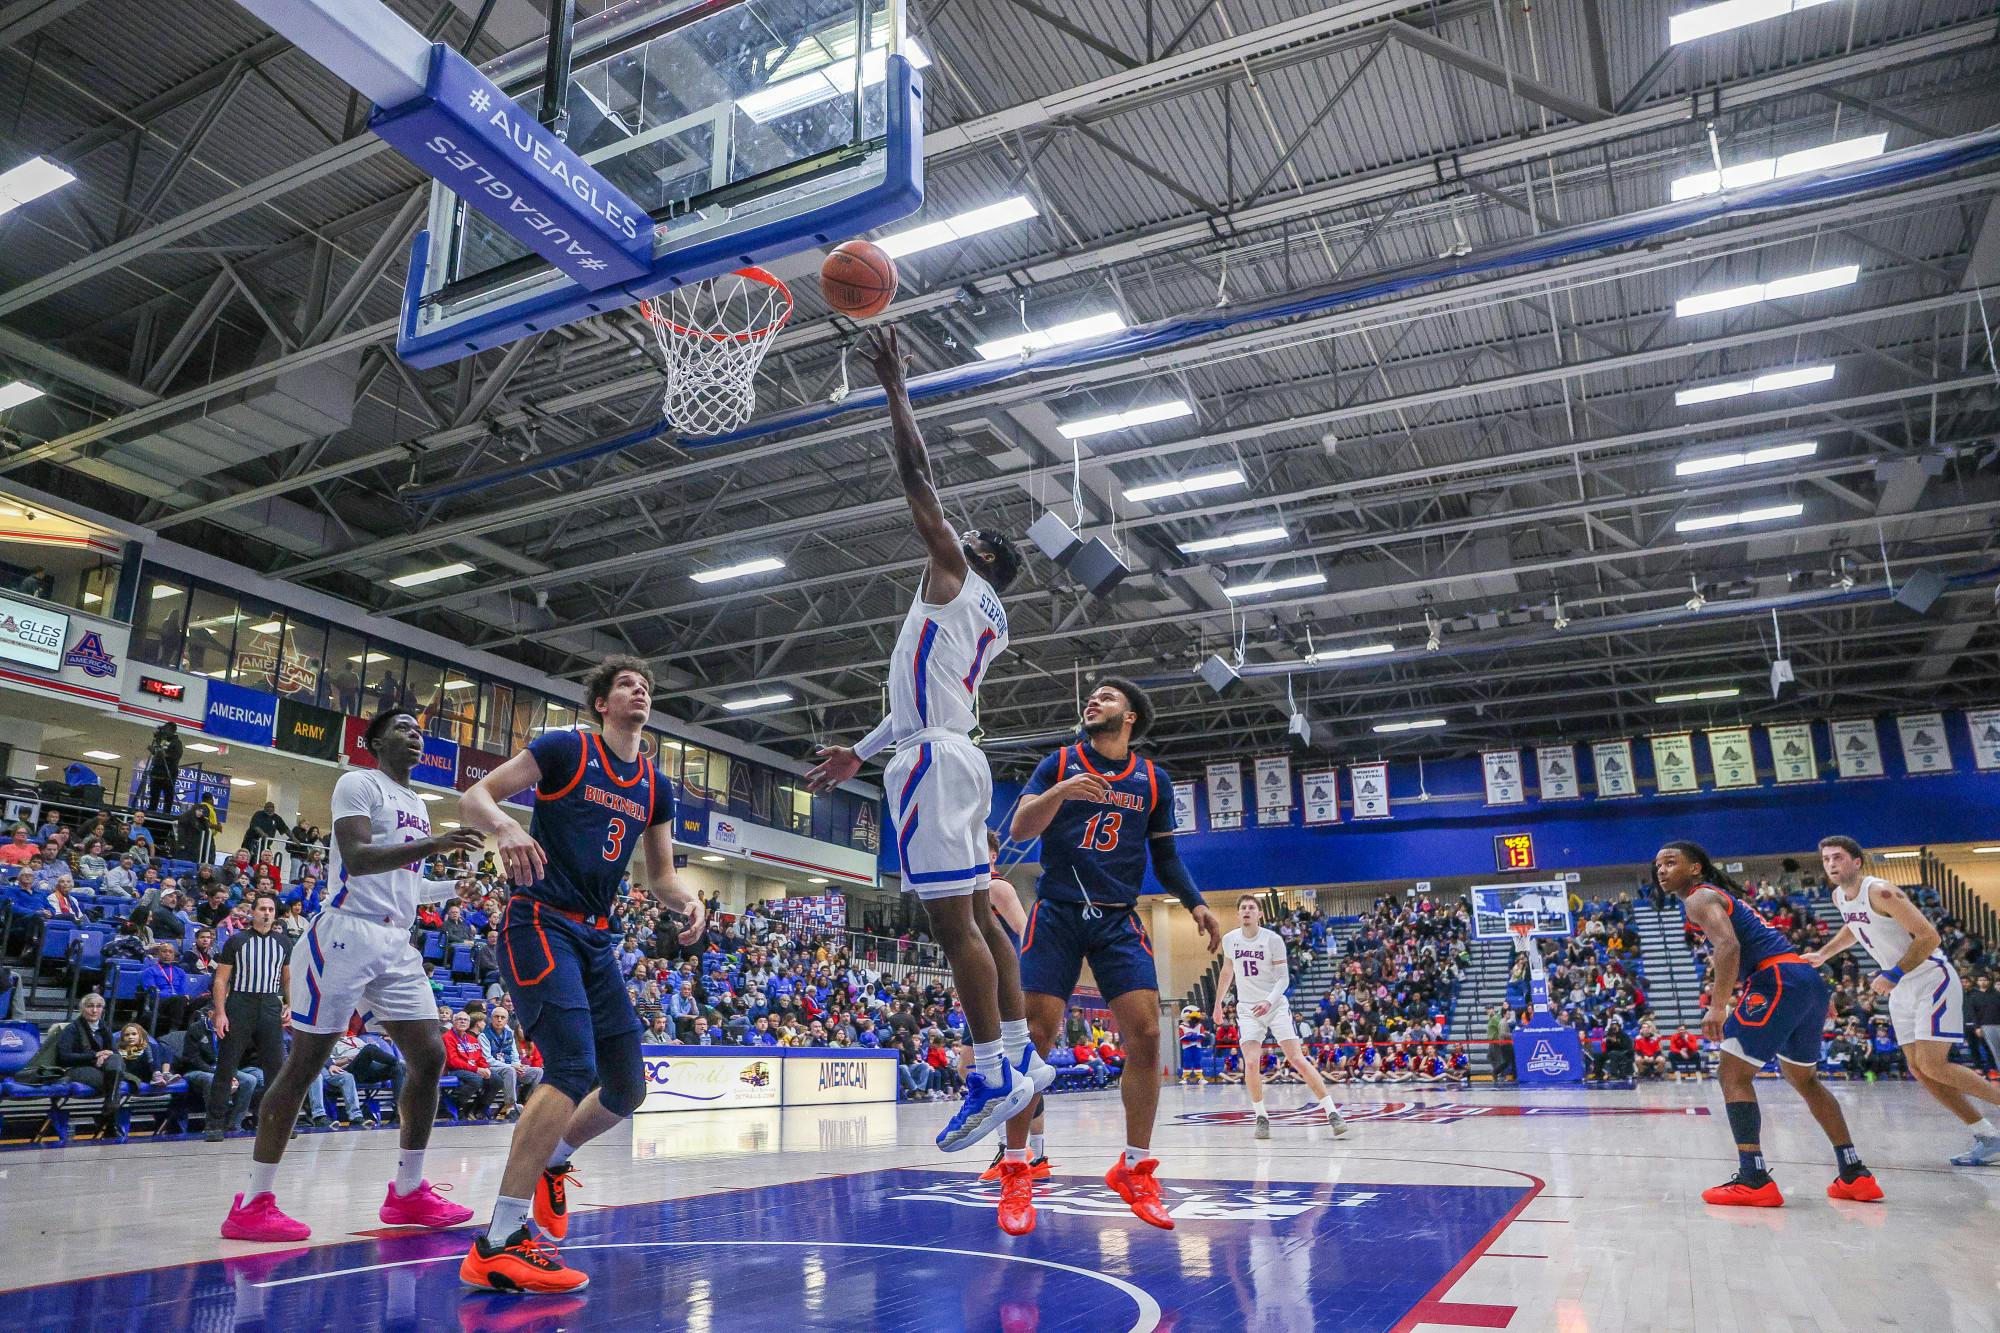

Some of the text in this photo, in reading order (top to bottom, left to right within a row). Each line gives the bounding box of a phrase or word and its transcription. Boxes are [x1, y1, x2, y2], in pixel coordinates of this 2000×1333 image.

[468, 88, 638, 240] #AUEAGLES
[425, 135, 609, 272] #AUEAGLES
[18, 631, 58, 648] CLUB
[68, 655, 115, 673] AMERICAN
[962, 626, 996, 694] 1
[209, 701, 273, 727] AMERICAN
[293, 721, 326, 741] ARMY
[584, 784, 648, 822] BUCKNELL
[684, 819, 701, 832] NAVY
[1077, 810, 1123, 852] 13
[602, 817, 626, 862] 3
[1510, 847, 1529, 867] 13
[1234, 949, 1265, 961] EAGLES
[1242, 960, 1259, 977] 15
[818, 1061, 868, 1091] AMERICAN
